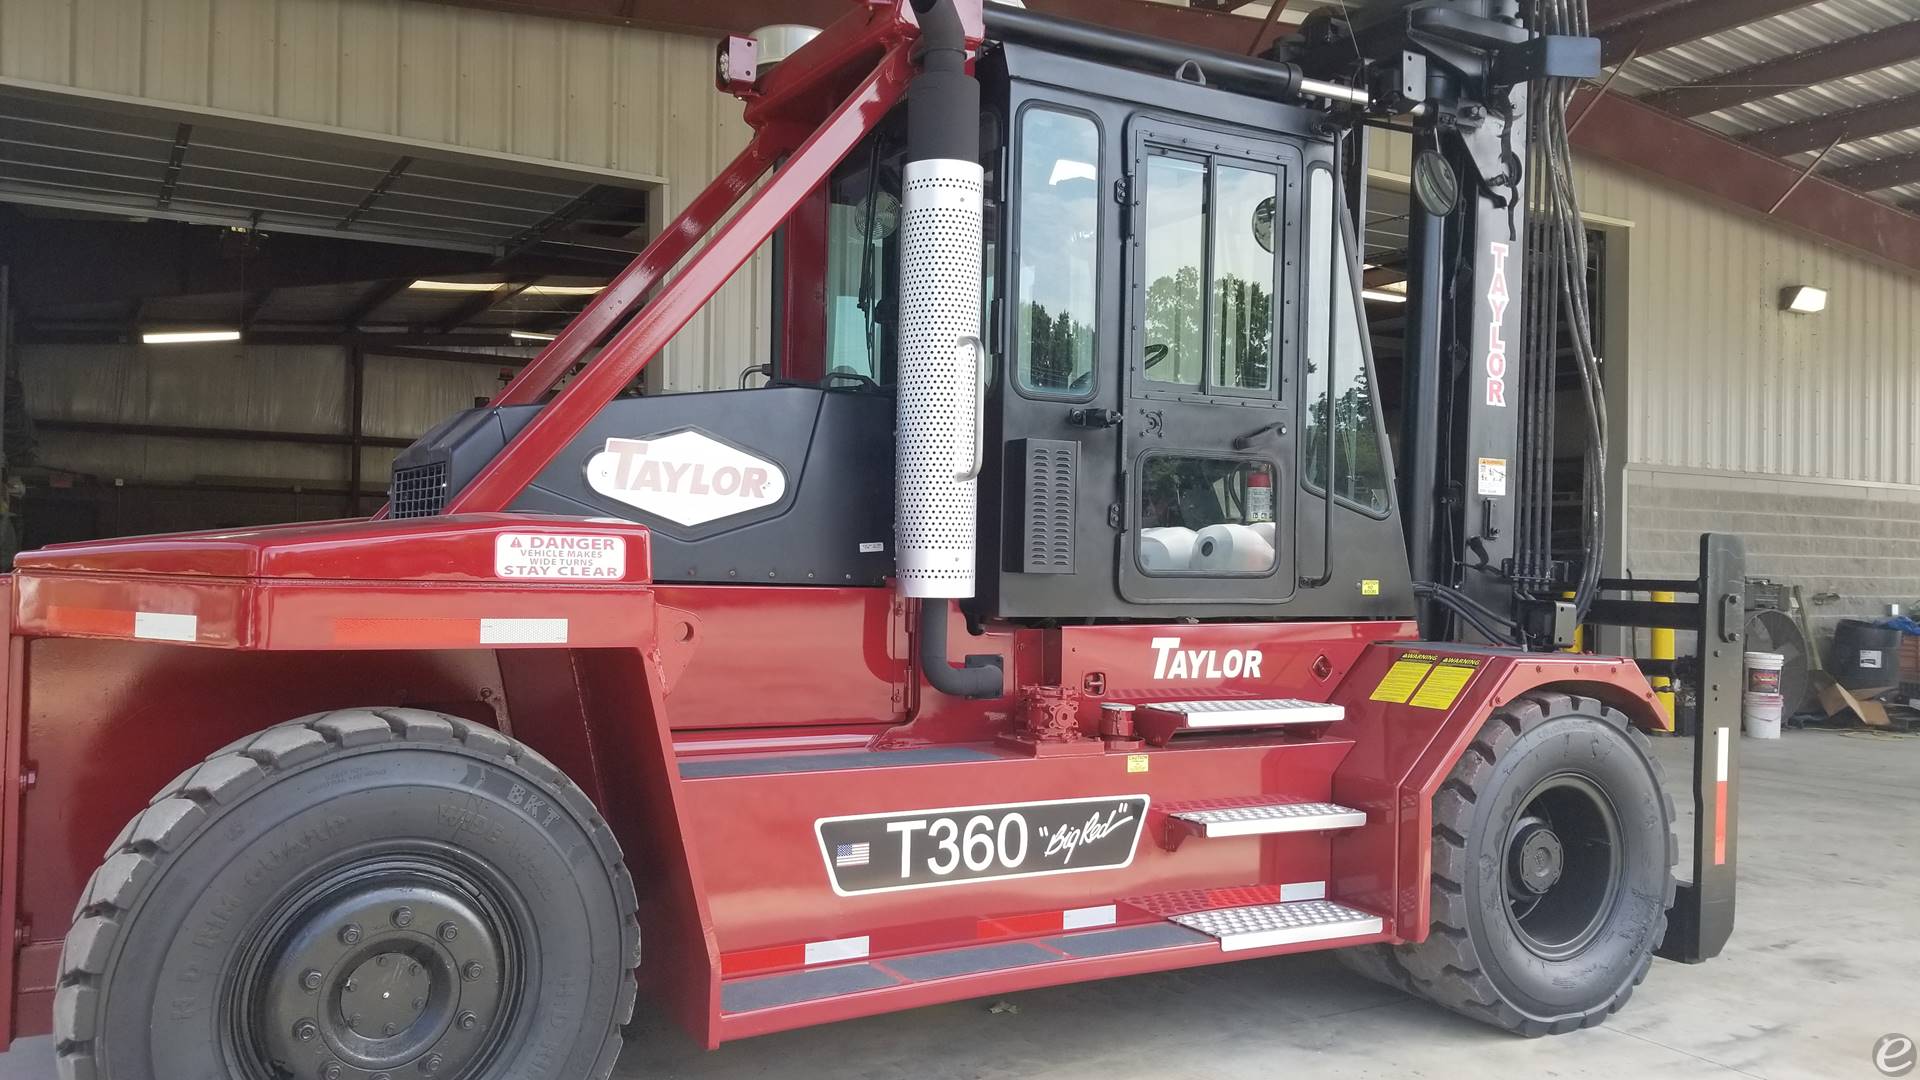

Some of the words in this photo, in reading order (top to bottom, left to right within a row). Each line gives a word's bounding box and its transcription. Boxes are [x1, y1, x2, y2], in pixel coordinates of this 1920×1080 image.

[1487, 242, 1510, 407] TAYLOR
[607, 441, 769, 499] TAYLOR
[530, 536, 615, 550] DANGER
[520, 549, 565, 558] VEHICLE
[567, 550, 603, 559] MAKES
[529, 558, 557, 566] WIDE
[560, 558, 594, 566] TURNS
[504, 565, 554, 576] STAY
[557, 566, 618, 577] CLEAR
[1151, 637, 1262, 680] TAYLOR
[1407, 653, 1439, 661] WARNING
[1447, 657, 1481, 666] WARNING
[506, 783, 561, 827] BKT
[886, 812, 1028, 879] T360
